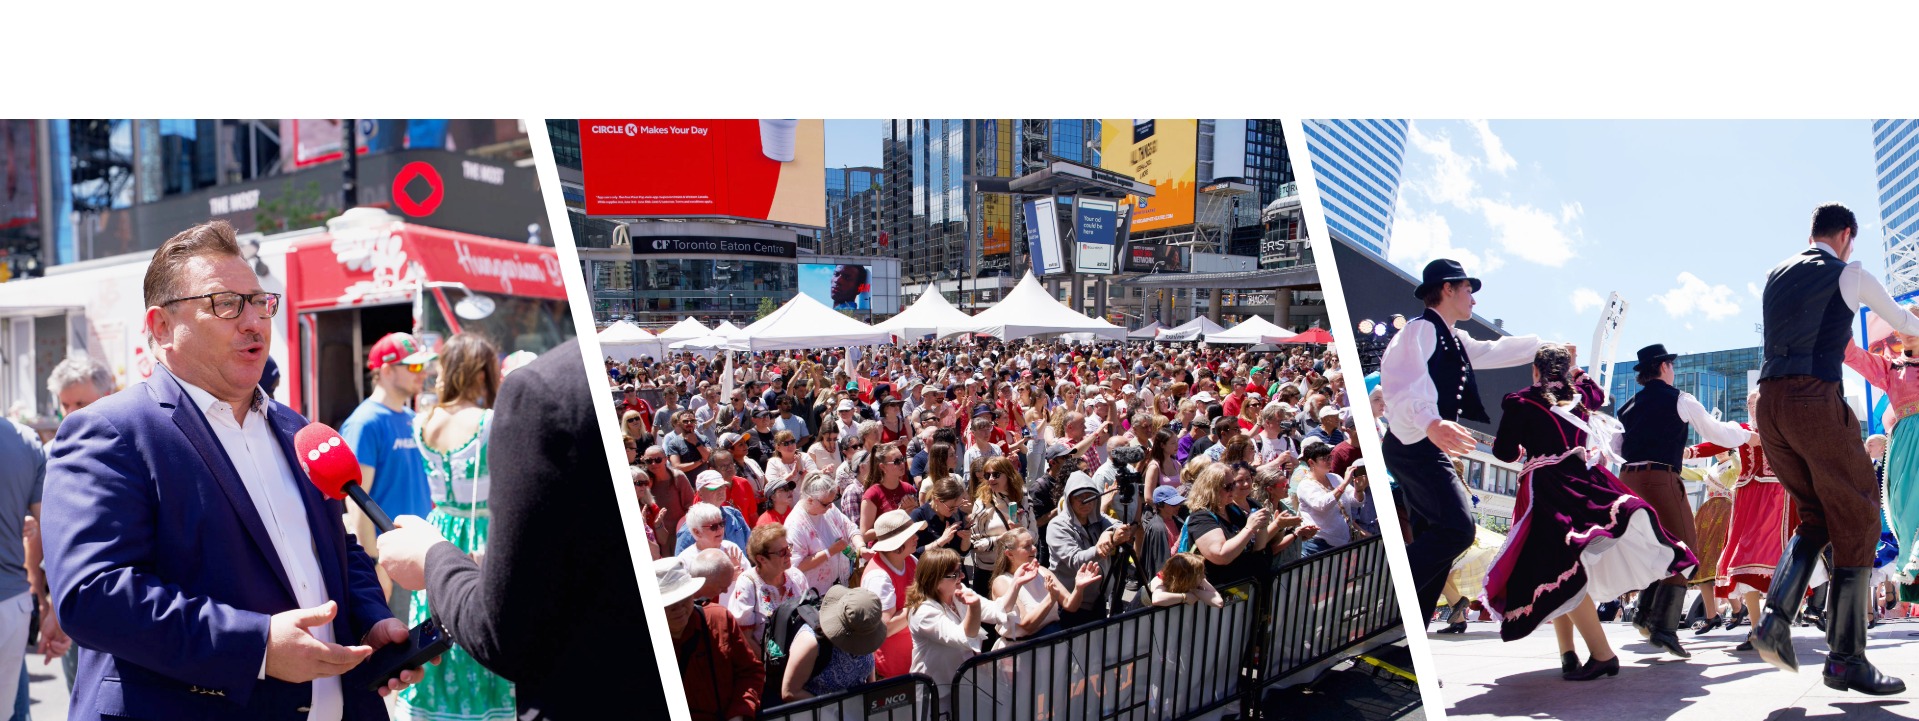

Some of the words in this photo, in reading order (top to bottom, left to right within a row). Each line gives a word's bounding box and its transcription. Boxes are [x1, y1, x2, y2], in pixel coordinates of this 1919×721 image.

[591, 125, 623, 134] CIRCLE
[640, 126, 668, 134] Makes
[669, 126, 689, 134] Your
[691, 126, 708, 136] Day
[651, 239, 671, 250] CF
[672, 239, 717, 250] Toronto
[720, 240, 751, 251] Eaton
[753, 242, 785, 254] Centre
[1133, 256, 1155, 264] NETWORK
[453, 239, 546, 295] Hungarian
